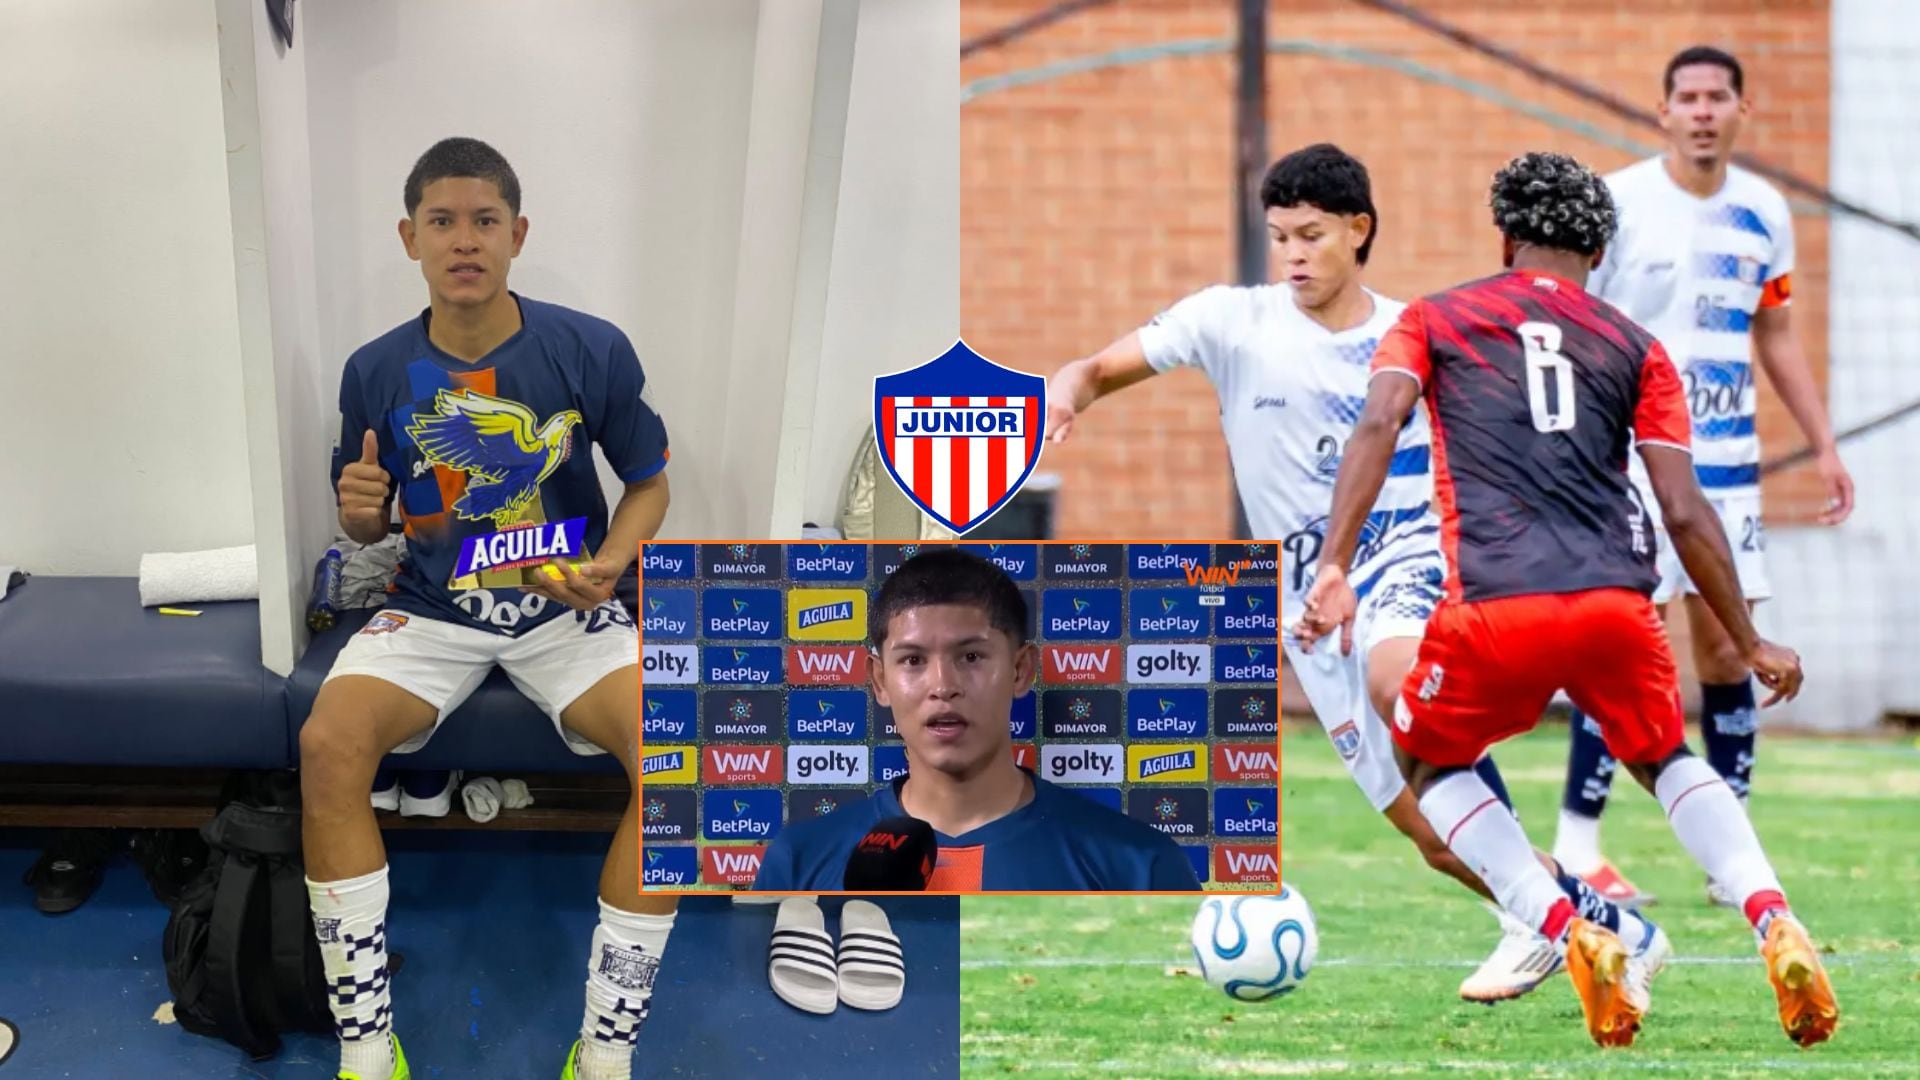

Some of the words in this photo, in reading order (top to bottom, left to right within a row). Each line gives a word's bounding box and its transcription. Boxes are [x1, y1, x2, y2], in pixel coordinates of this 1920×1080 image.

[469, 523, 570, 572] AGUILA
[713, 564, 766, 574] DIMAYOR
[796, 557, 854, 574] BetPlay
[1055, 564, 1107, 573] DIMAYOR
[1138, 554, 1198, 571] BetPlay
[802, 604, 850, 627] AGUILA
[711, 617, 769, 634] BetPlay
[1052, 617, 1110, 633] BetPlay
[1140, 616, 1199, 632] BetPlay
[797, 650, 855, 674] WIN
[1052, 649, 1110, 673] WIN
[1137, 650, 1201, 677] golty.
[712, 667, 769, 683] BetPlay
[812, 674, 840, 682] sports
[1067, 673, 1095, 681] sports
[642, 718, 684, 735] tPlay
[715, 725, 767, 734] DIMAYOR
[797, 718, 855, 734] BetPlay
[1055, 724, 1107, 733] DIMAYOR
[1137, 718, 1196, 733] BetPlay
[712, 750, 771, 774] WIN
[797, 750, 859, 777] golty.
[1051, 749, 1114, 776] golty.
[1143, 753, 1192, 776] AGUILA
[727, 774, 756, 782] sports
[1240, 772, 1270, 780] sports
[712, 819, 770, 835] BetPlay
[642, 868, 684, 884] tPlay
[727, 874, 755, 883] sports
[1241, 874, 1271, 882] sports
